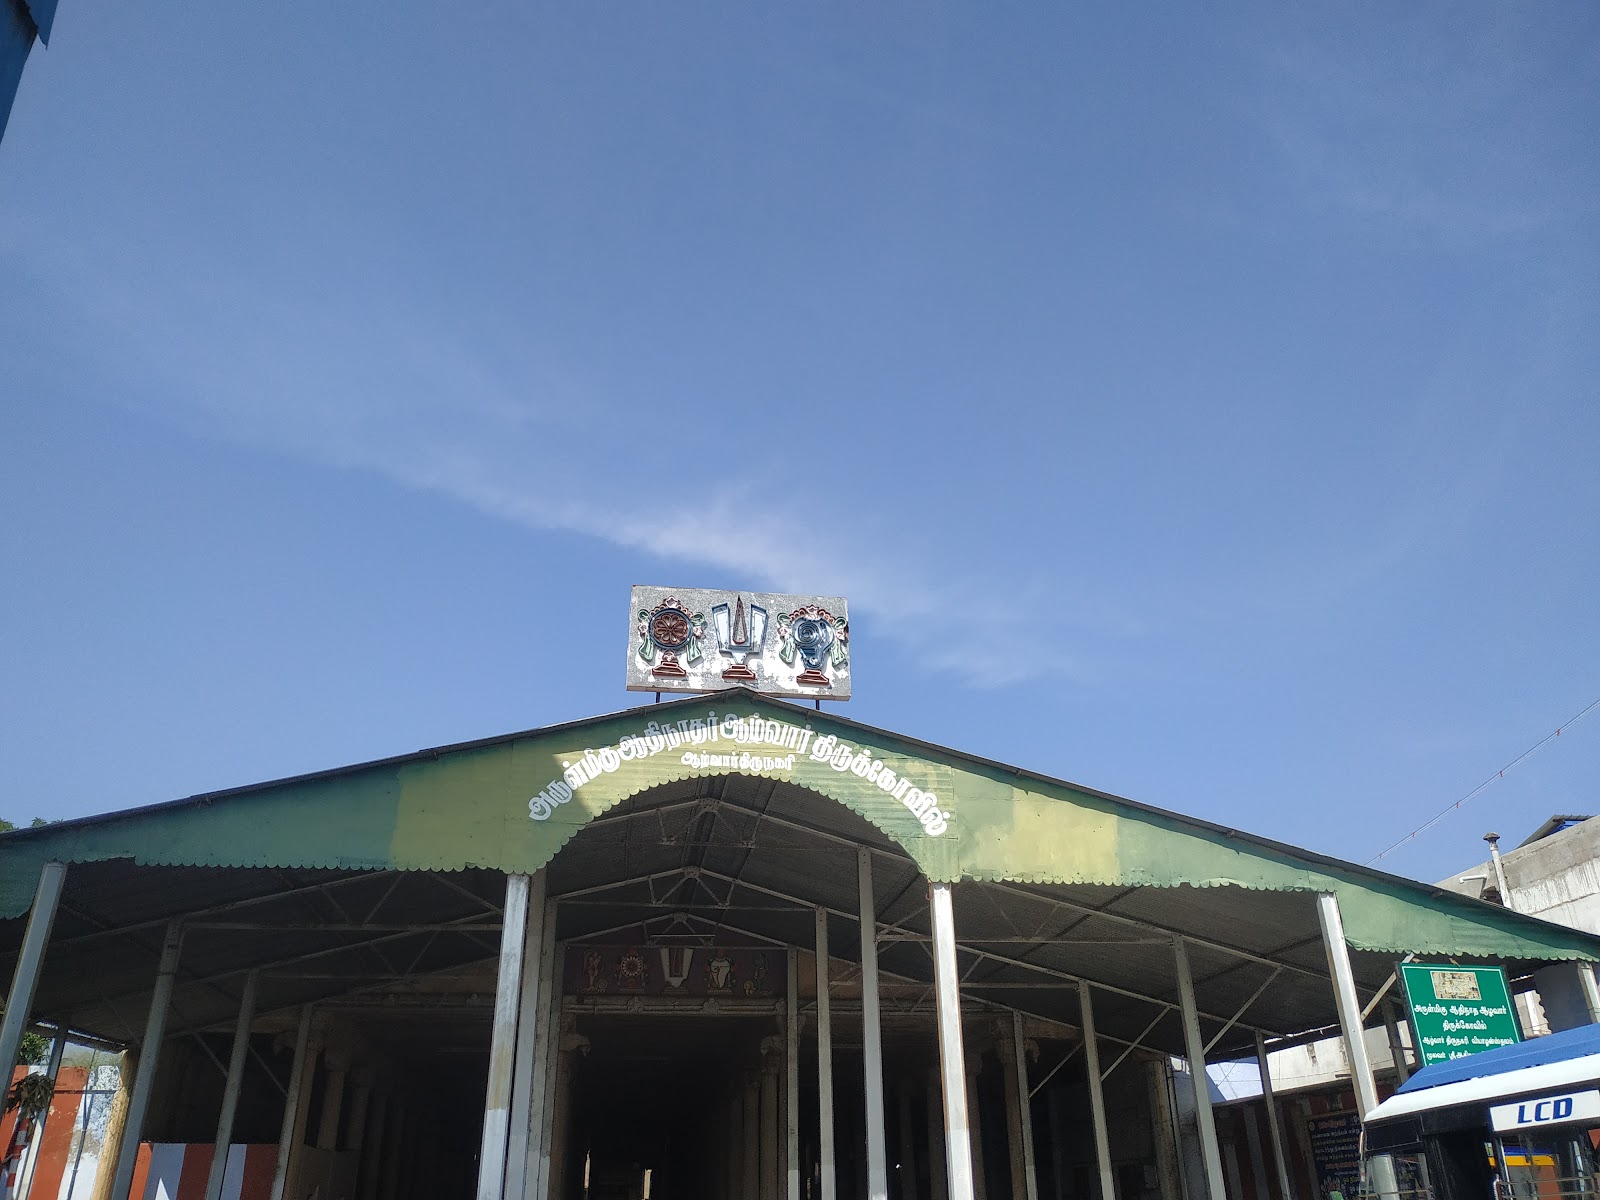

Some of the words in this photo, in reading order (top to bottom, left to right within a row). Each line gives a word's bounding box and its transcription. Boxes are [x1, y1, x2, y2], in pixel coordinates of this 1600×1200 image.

[528, 747, 621, 820] அருள்மிகு
[618, 711, 719, 761] ஆதிநாதர்
[719, 712, 814, 754] ஆழ்வார்
[1517, 1097, 1573, 1124] LCD
